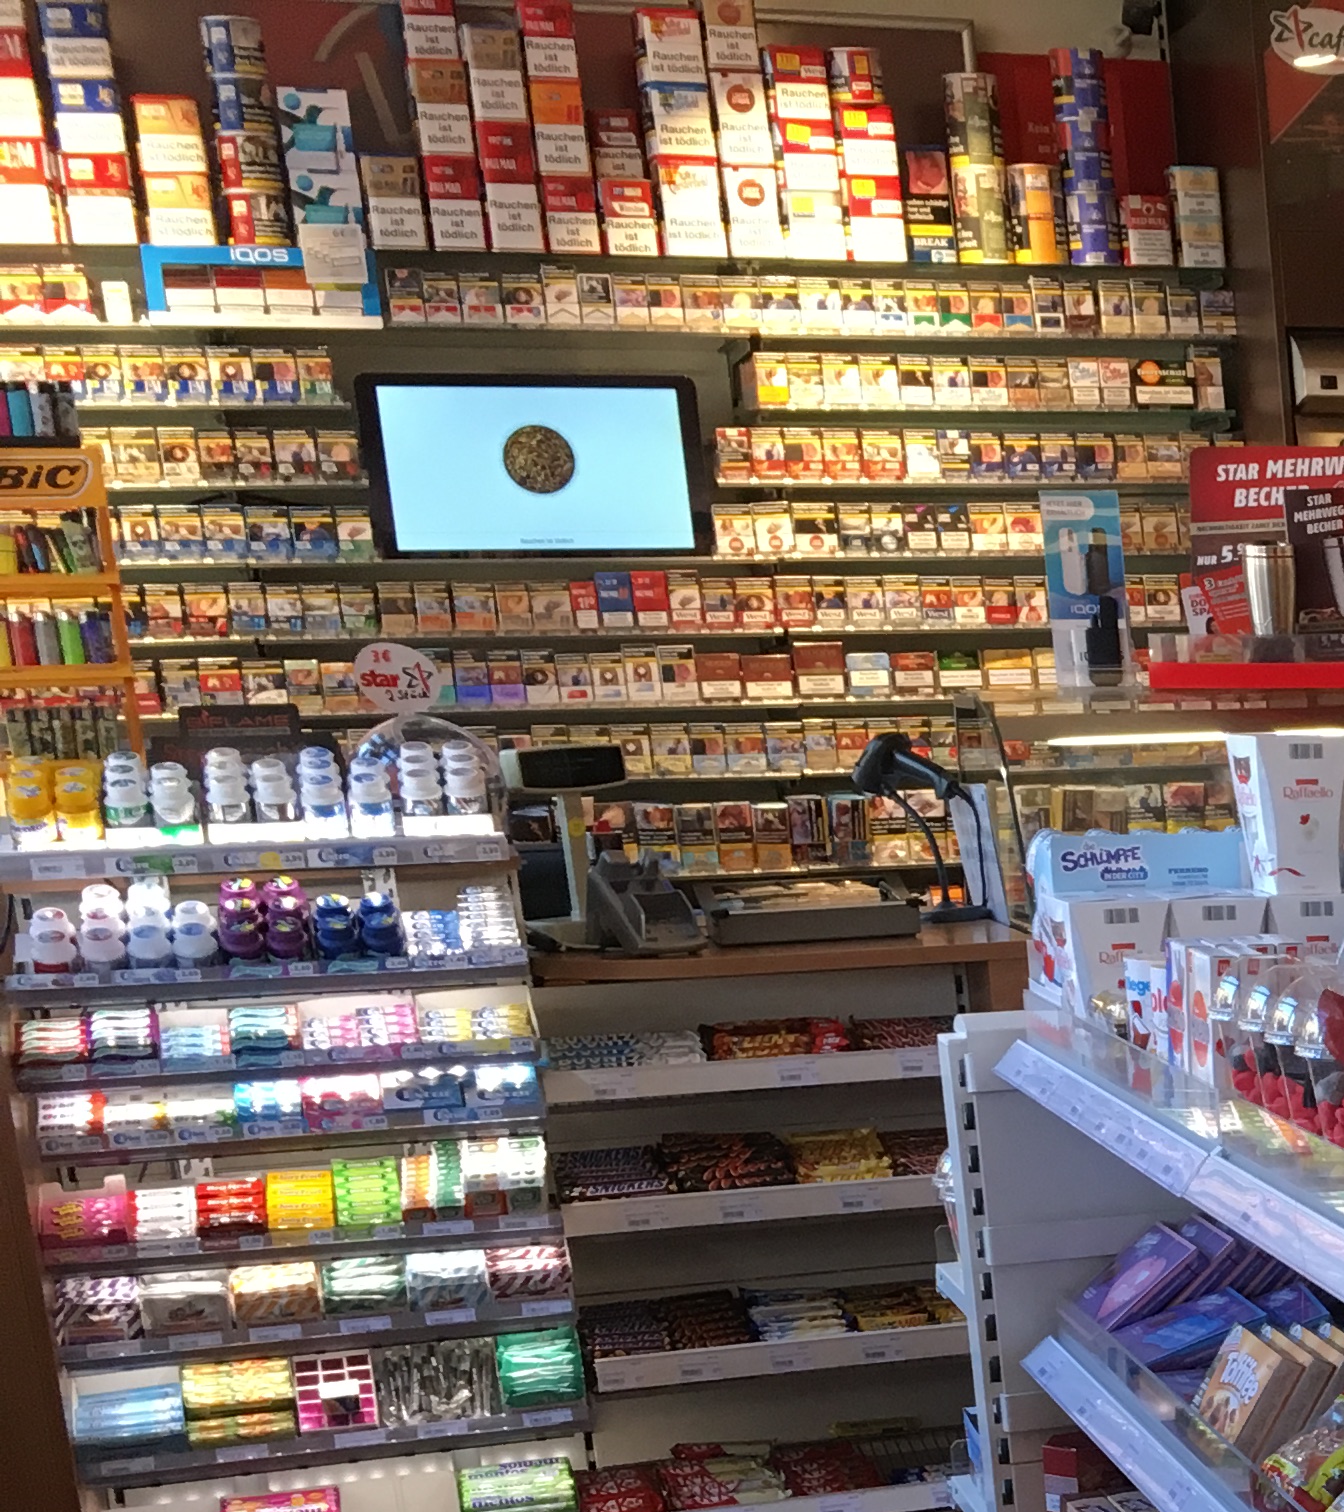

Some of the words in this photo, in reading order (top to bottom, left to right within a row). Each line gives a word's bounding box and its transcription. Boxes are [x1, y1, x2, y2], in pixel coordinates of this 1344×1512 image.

[708, 28, 754, 40] Rauchen
[525, 40, 575, 51] Rauchen
[726, 41, 740, 50] ist
[543, 52, 558, 62] ist
[652, 51, 700, 63] Rauchen
[651, 63, 665, 73] ist
[660, 124, 707, 135] Rauchen
[537, 132, 584, 142] Rauchen
[659, 136, 673, 146] ist
[554, 143, 568, 152] ist
[548, 215, 596, 226] Rauchen
[606, 220, 654, 231] Rauchen
[566, 227, 580, 236] ist
[624, 231, 639, 241] ist
[914, 237, 949, 247] BREAK
[1216, 463, 1259, 482] STAR
[1306, 493, 1332, 507] STAR
[1306, 519, 1344, 535] BECHER
[1197, 555, 1217, 566] NUR
[360, 669, 400, 688] star
[1283, 785, 1333, 800] Raffaello
[1128, 871, 1145, 880] CITY
